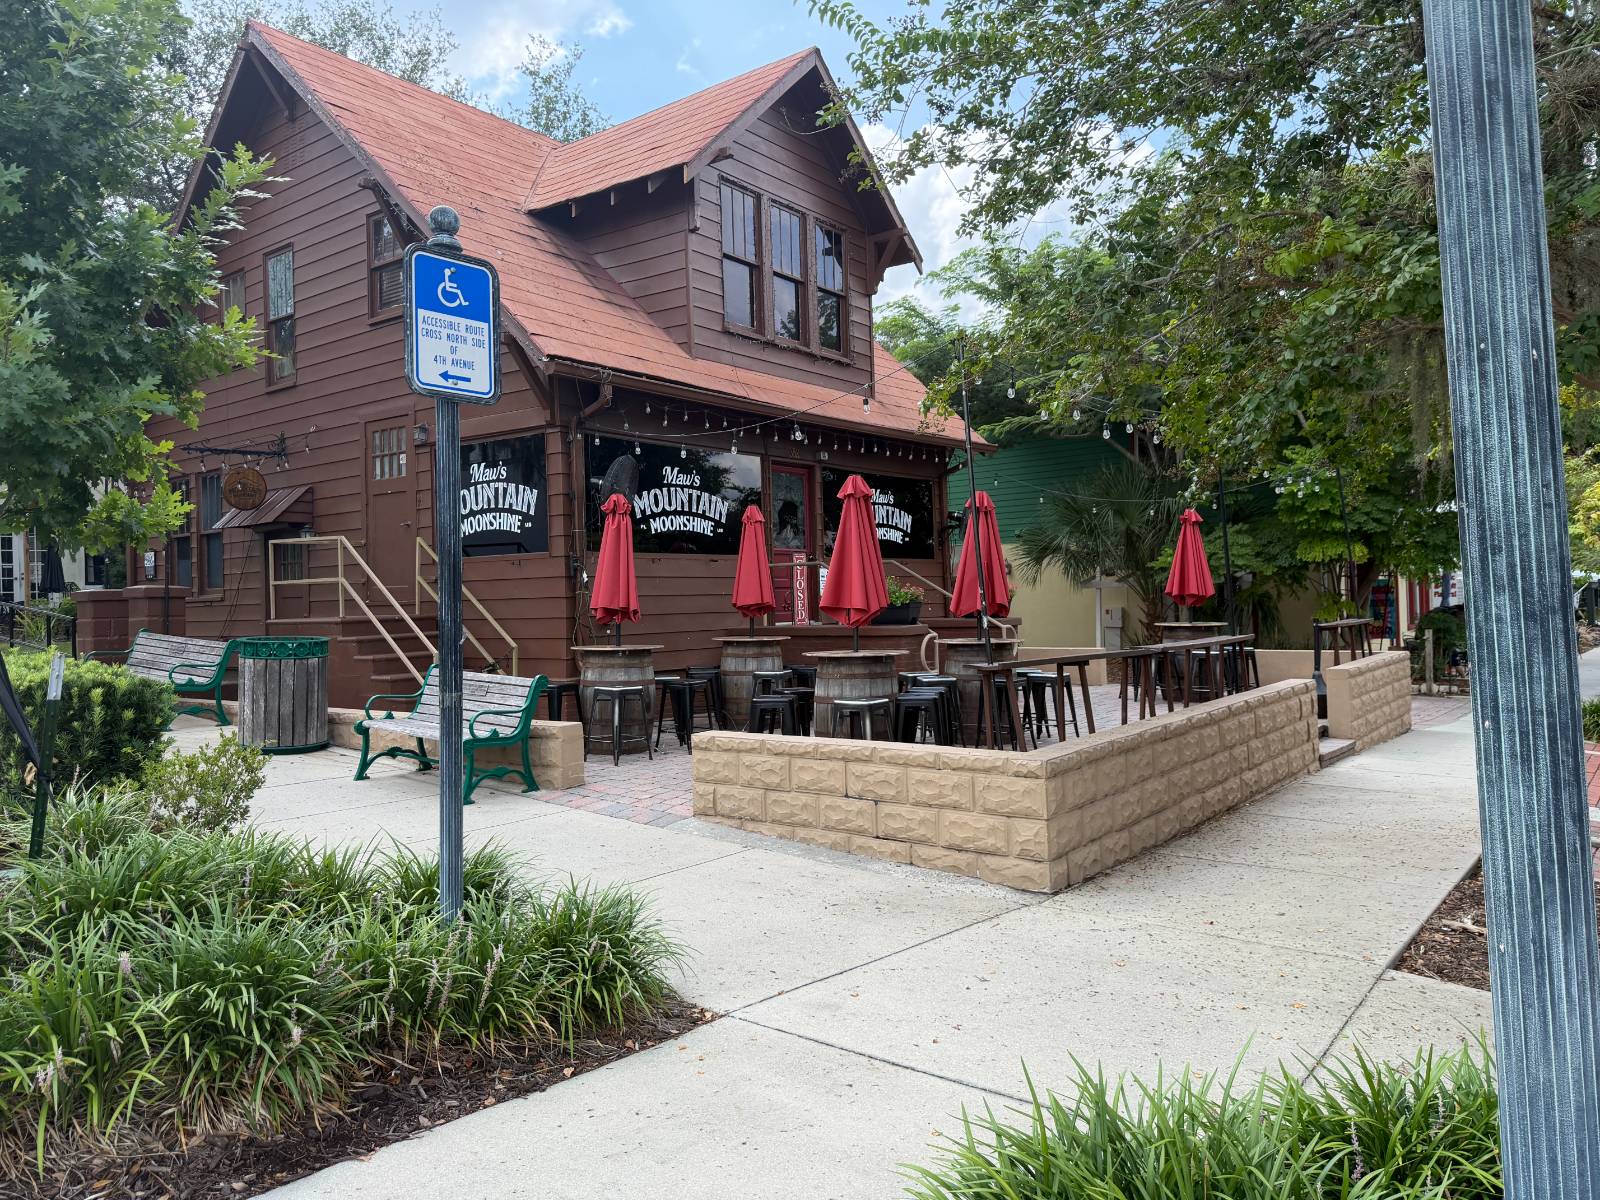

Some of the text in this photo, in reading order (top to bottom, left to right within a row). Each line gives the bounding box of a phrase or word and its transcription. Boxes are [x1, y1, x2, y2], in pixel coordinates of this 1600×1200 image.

[421, 315, 485, 337] ACCESSIBLE ROUTE
[421, 327, 486, 349] CROSS NORTH SIDE
[450, 345, 458, 356] OF
[433, 355, 475, 371] 4TH AVENUE
[470, 460, 507, 483] Maw's
[662, 465, 701, 487] Maw's
[460, 481, 538, 516] OUNTAIN
[633, 487, 729, 524] MOUNTAIN
[460, 512, 523, 538] MOONSHINE
[649, 514, 715, 537] MOONSHINE
[871, 504, 913, 534] UNTAIN
[796, 559, 805, 620] CLOSED
